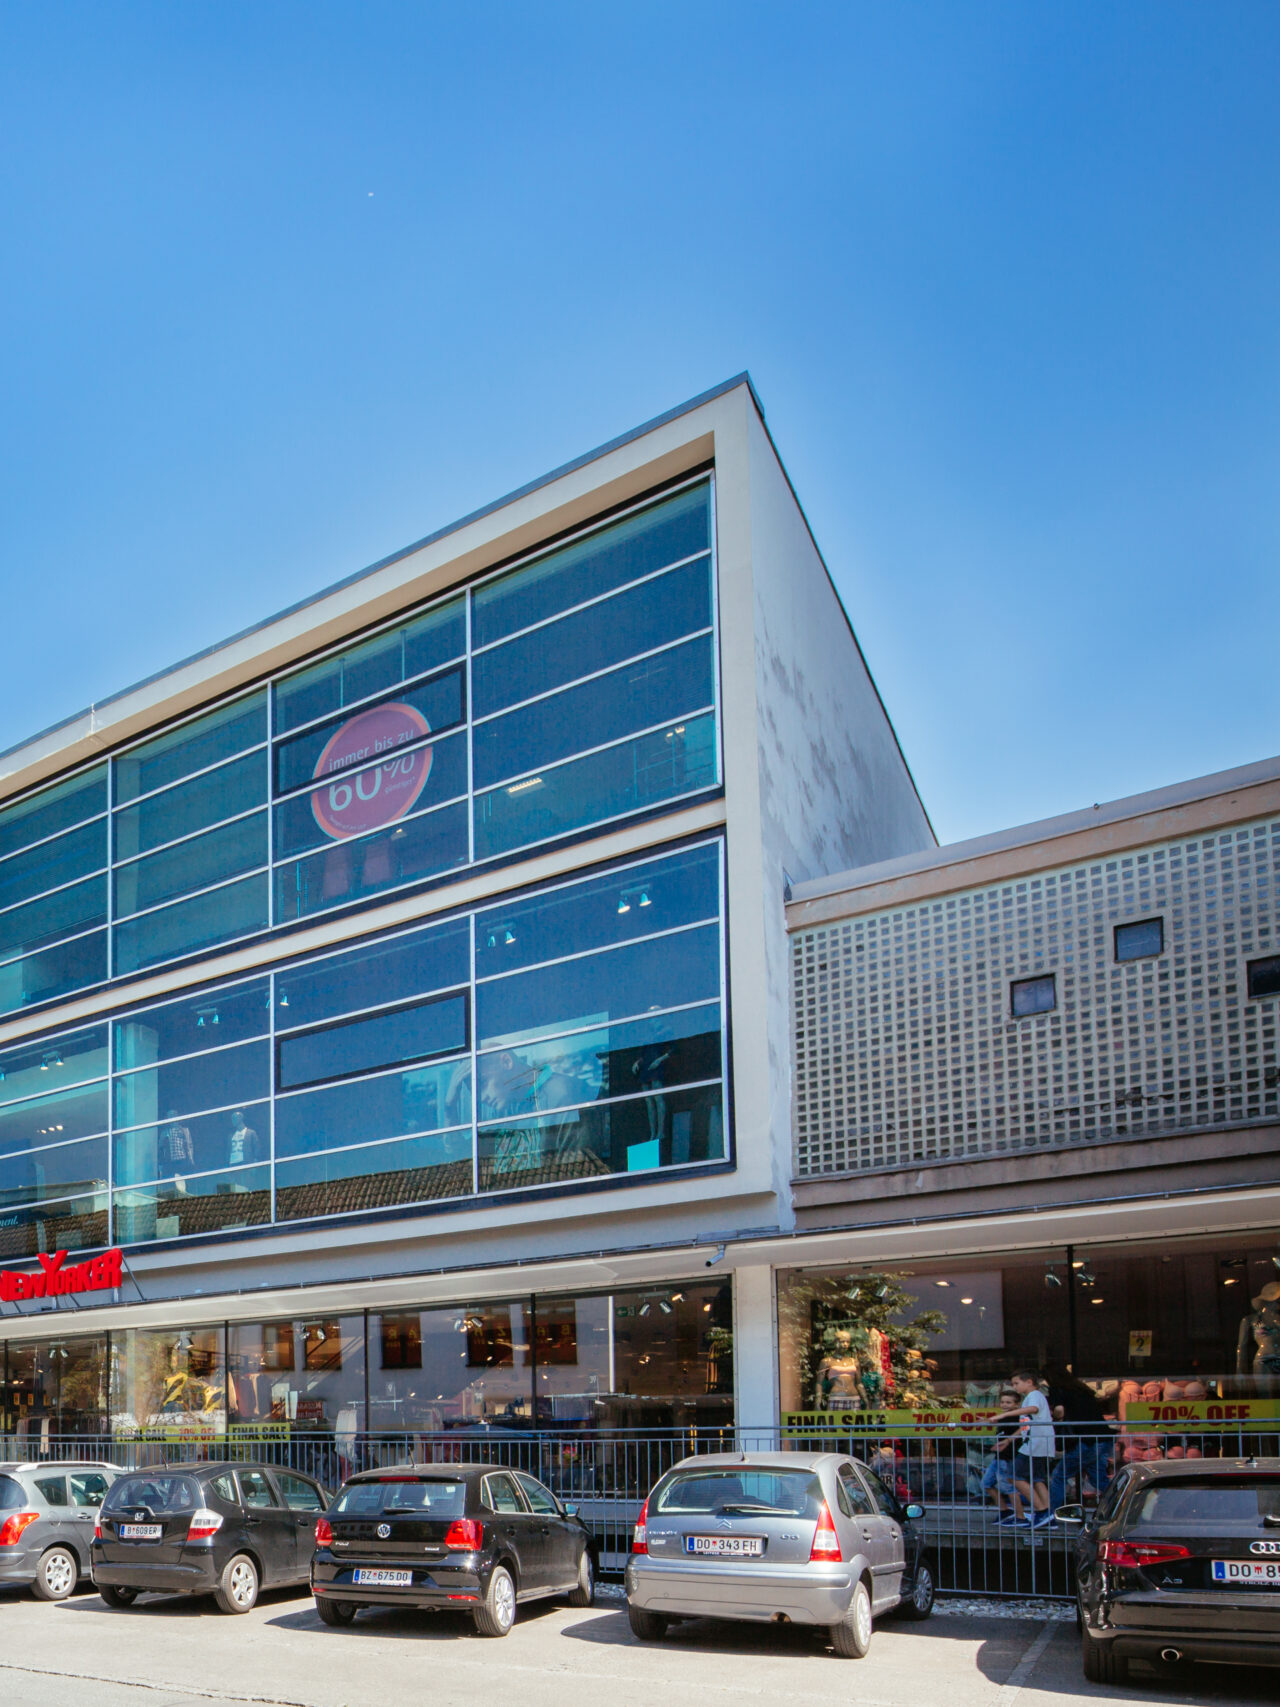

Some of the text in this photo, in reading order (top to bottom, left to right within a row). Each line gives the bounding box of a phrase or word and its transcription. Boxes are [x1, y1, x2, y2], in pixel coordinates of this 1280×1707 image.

[328, 729, 414, 772] immer bis zu
[787, 1414, 835, 1434] FINAL
[841, 1413, 887, 1433] SALE
[912, 1412, 956, 1433] 70%
[1148, 1404, 1251, 1427] 70% OFF
[232, 1425, 288, 1441] FINAL SALE
[696, 1538, 757, 1552] DO 343 EH
[360, 1570, 372, 1580] BZ
[377, 1571, 395, 1581] 675
[1228, 1563, 1252, 1578] DO
